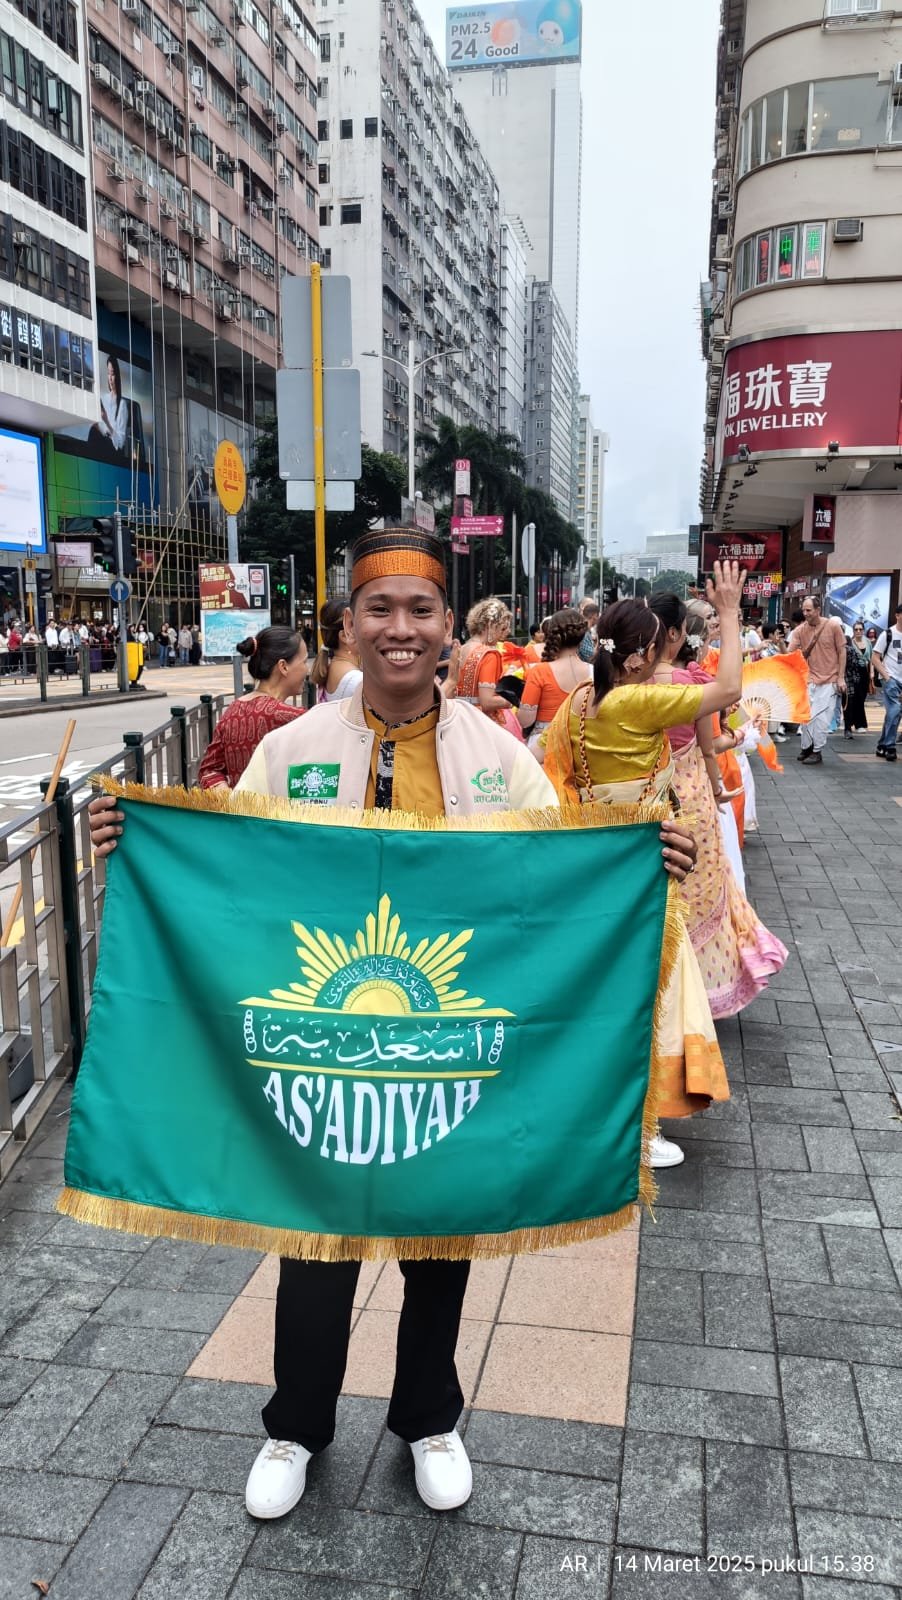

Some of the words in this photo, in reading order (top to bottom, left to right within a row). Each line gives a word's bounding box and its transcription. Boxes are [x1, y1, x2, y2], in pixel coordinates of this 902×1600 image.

[451, 22, 491, 36] PM2.5
[451, 38, 478, 60] 24
[485, 43, 519, 57] Good
[780, 234, 792, 259] 中
[725, 360, 832, 419] 福珠寶
[736, 411, 828, 438] JEWELLERY
[815, 508, 832, 523] 六福
[718, 543, 766, 555] 六福珠寶
[262, 1071, 483, 1165] AS'ADIYAH
